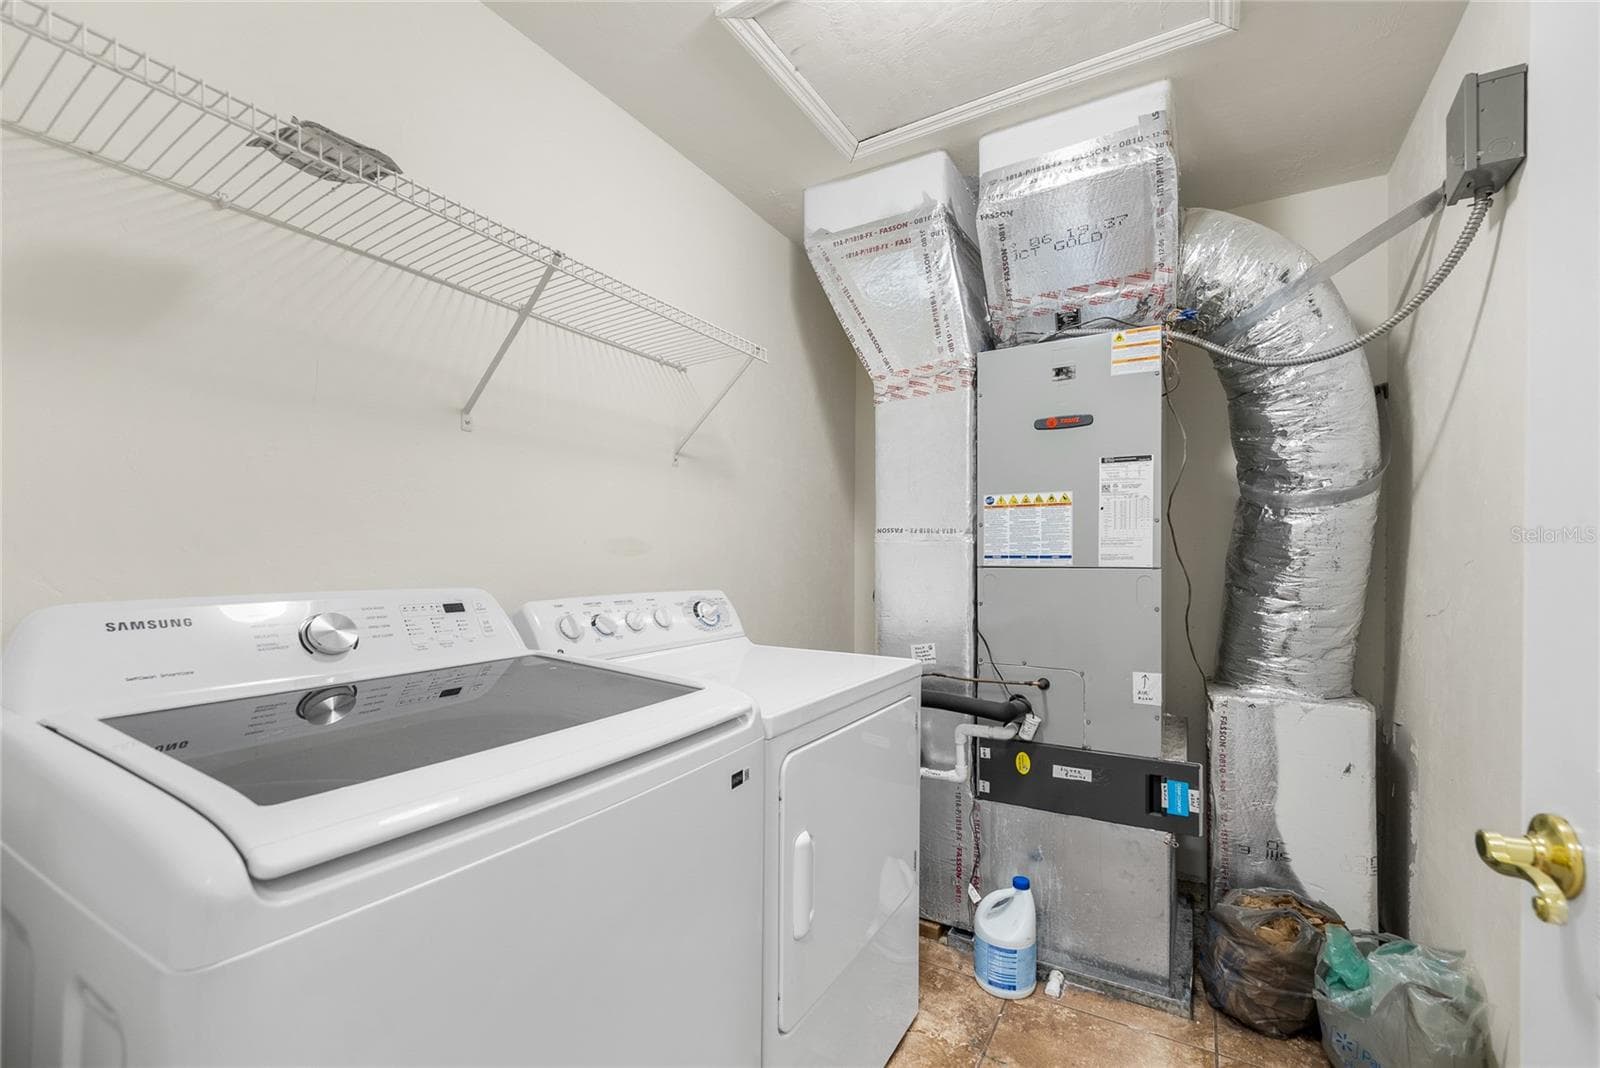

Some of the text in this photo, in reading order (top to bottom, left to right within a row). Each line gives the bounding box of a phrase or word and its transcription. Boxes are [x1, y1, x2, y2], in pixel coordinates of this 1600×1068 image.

[879, 221, 909, 236] FASSON
[1000, 247, 1011, 281] FASSON
[866, 327, 884, 355] FASSON
[105, 618, 193, 632] SAMSUNG
[1218, 715, 1228, 747] FASSON
[1218, 753, 1227, 774] 0810
[955, 847, 963, 880] FASSON
